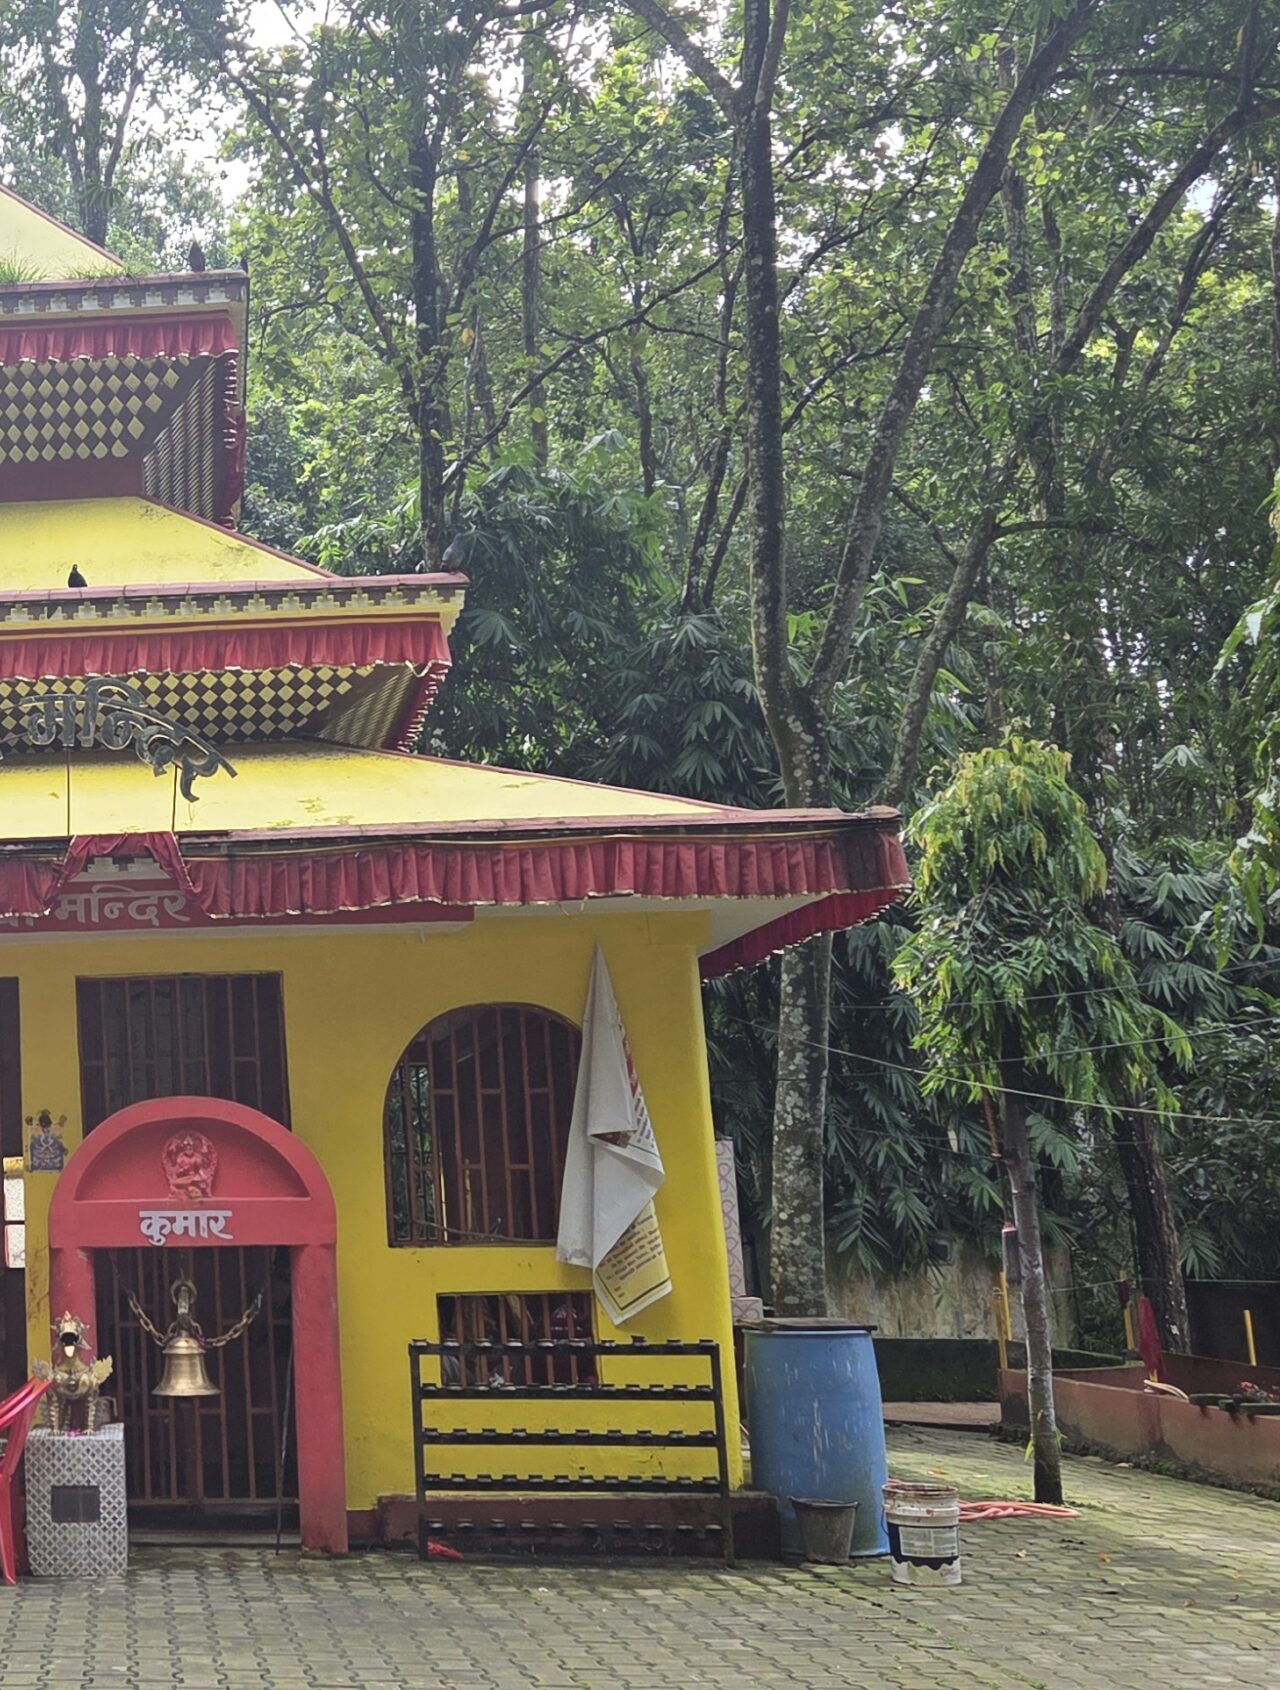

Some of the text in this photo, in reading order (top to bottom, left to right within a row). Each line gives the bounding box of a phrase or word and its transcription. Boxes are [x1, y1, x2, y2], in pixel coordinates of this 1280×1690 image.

[21, 678, 239, 803] मन्दिर
[55, 884, 191, 928] मन्दिर
[139, 1210, 234, 1246] कुमार
